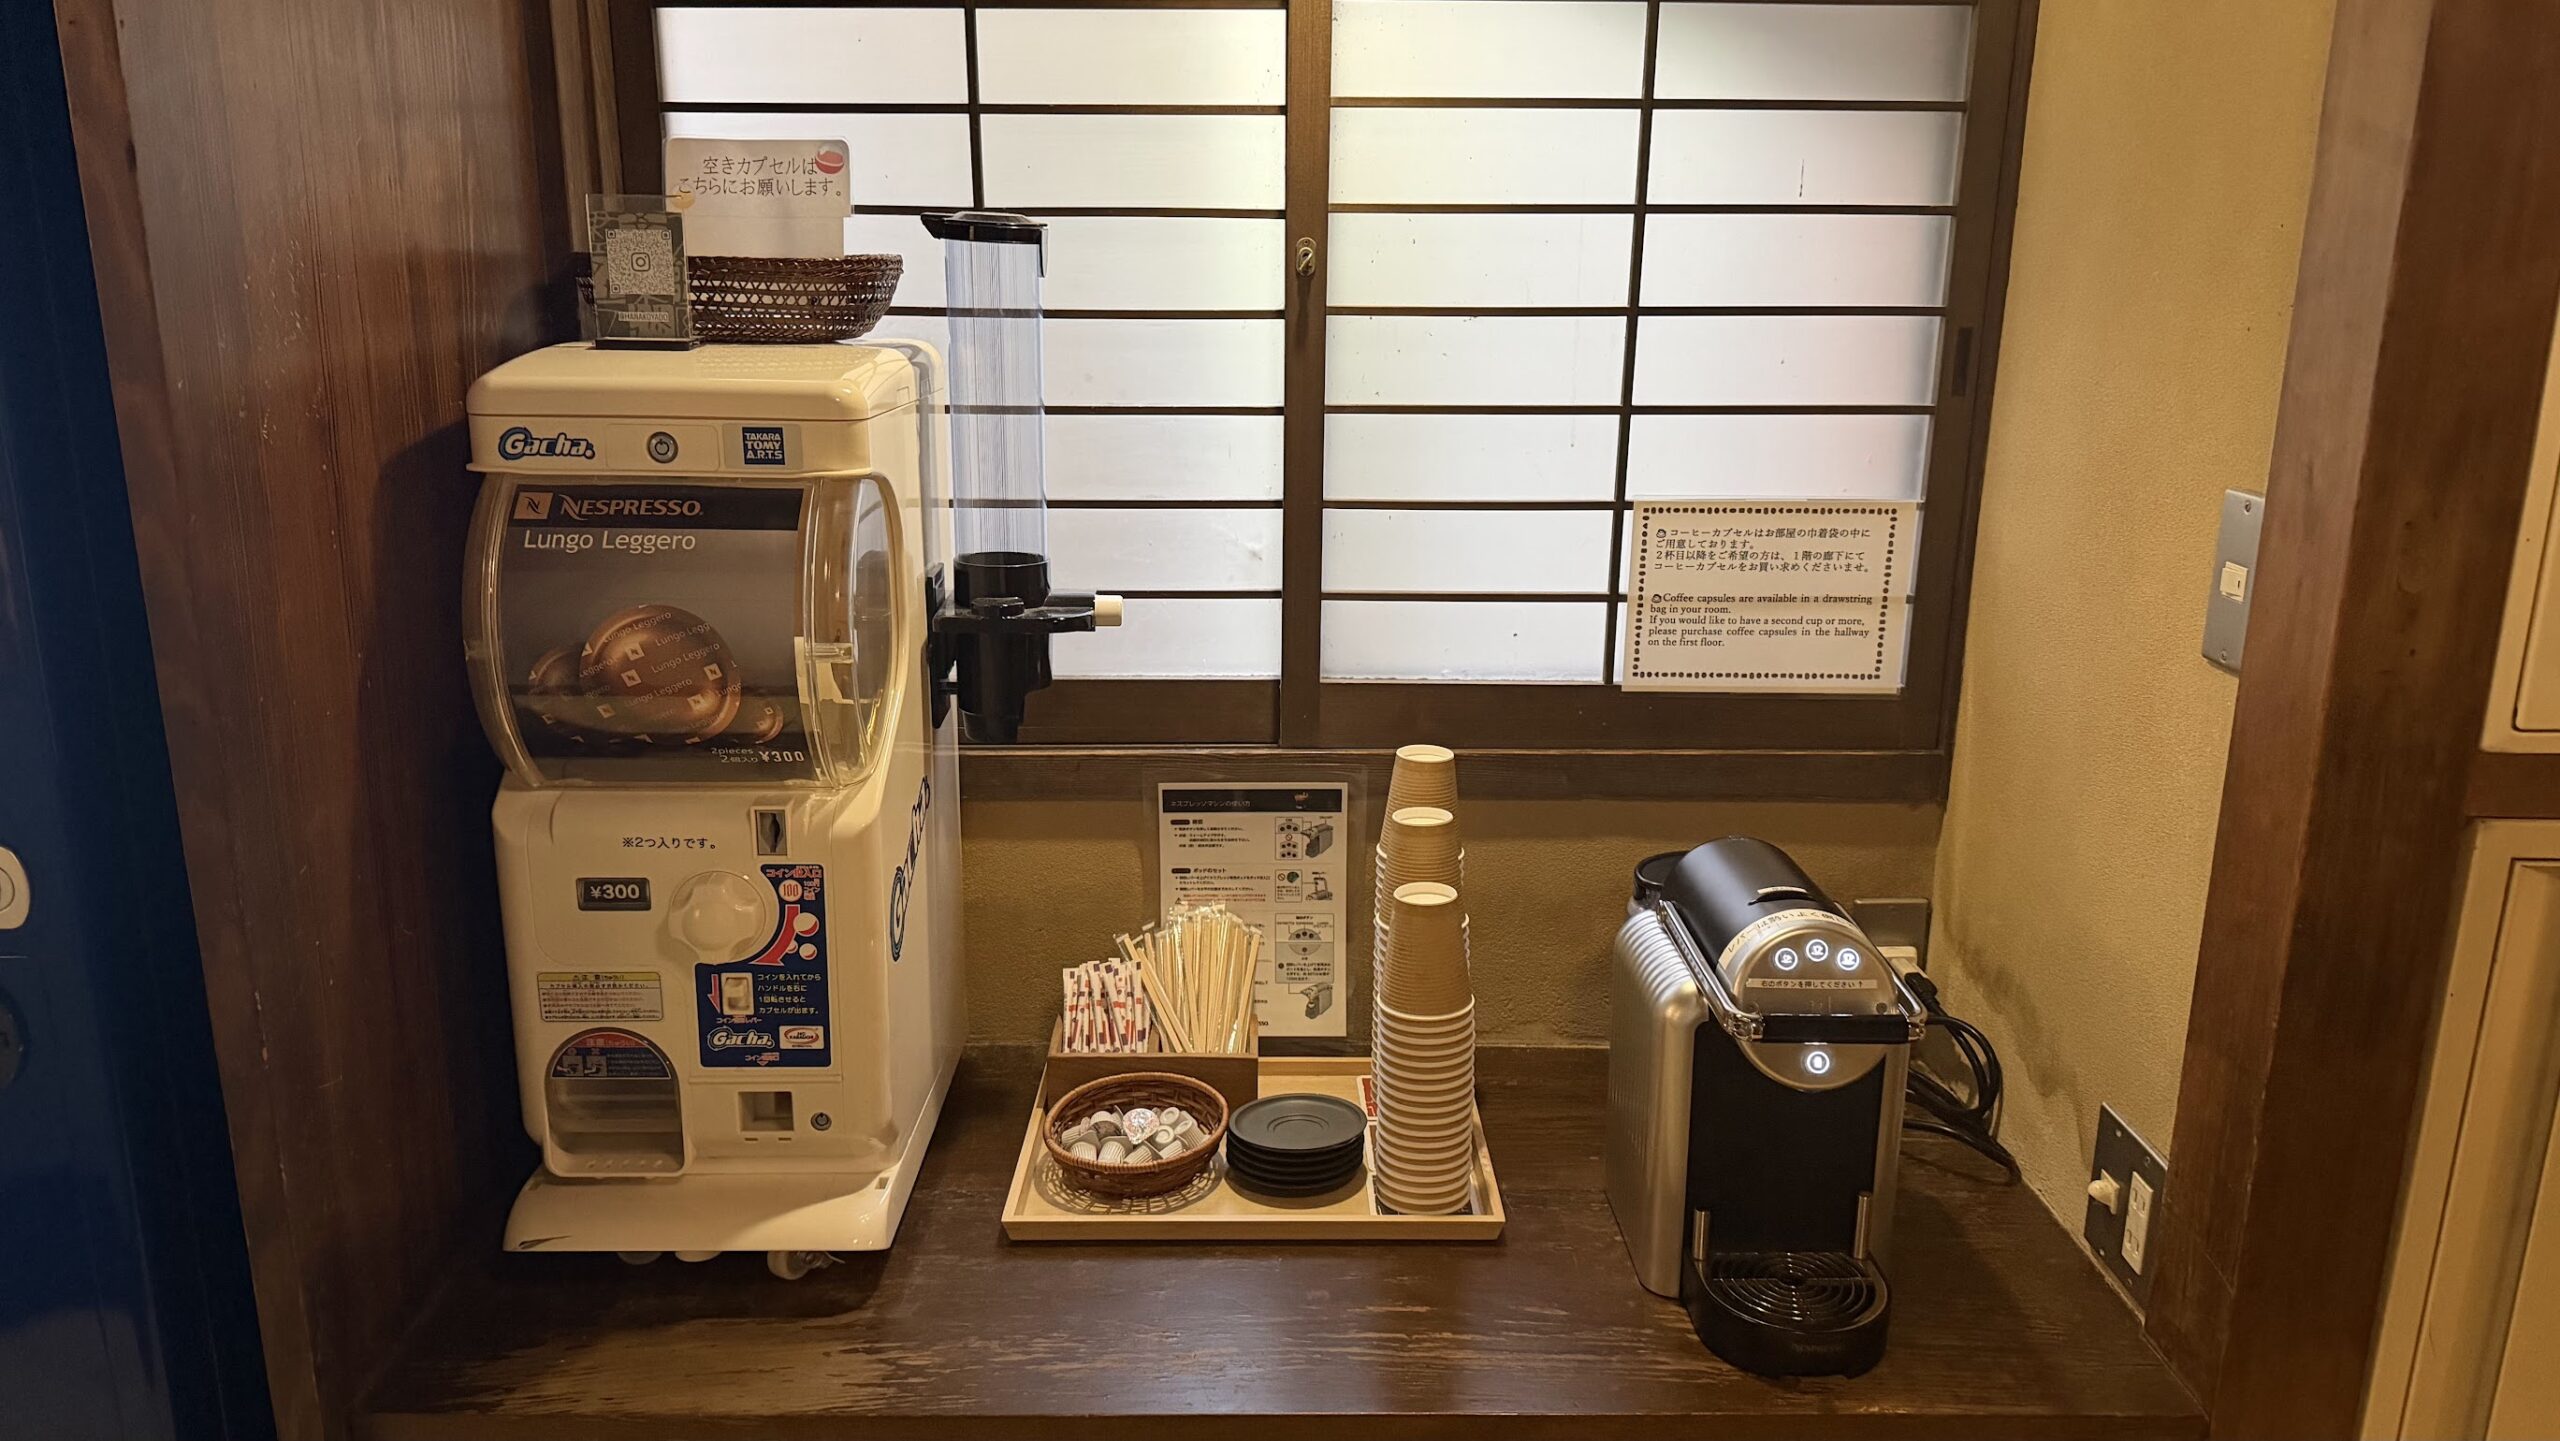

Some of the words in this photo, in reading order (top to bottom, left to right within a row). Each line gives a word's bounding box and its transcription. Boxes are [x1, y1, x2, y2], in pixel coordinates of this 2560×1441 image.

[702, 156, 817, 176] 空きカプセルは
[678, 178, 842, 197] こちらにお願いします。
[744, 432, 781, 442] TAKARA
[745, 441, 781, 450] TOMY
[524, 529, 594, 553] Lungo
[602, 530, 696, 554] Leggero
[1656, 539, 1754, 549] ご用意しております。
[1654, 562, 1869, 572] コーヒーカプセルをお買い求めくださいませ。
[1663, 593, 1694, 603] Coffee
[1697, 594, 1736, 605] capsules
[1757, 594, 1797, 603] available
[1801, 594, 1810, 603] in
[1822, 594, 1872, 605] drawstring
[1651, 605, 1667, 615] bag
[1670, 605, 1678, 614] in
[1681, 606, 1701, 616] your
[1705, 606, 1731, 614] room.
[1650, 616, 1658, 625] If
[1659, 617, 1676, 627] you
[1679, 616, 1706, 625] would
[1709, 616, 1726, 625] like
[1728, 617, 1737, 625] to
[1740, 616, 1760, 625] have
[1771, 616, 1803, 625] second
[1806, 617, 1822, 627] cup
[1838, 618, 1864, 626] more,
[1649, 627, 1677, 637] please
[1681, 627, 1722, 638] purchase
[1726, 627, 1754, 636] coffee
[1759, 627, 1797, 638] capsules
[1801, 628, 1810, 636] in
[1815, 628, 1830, 636] the
[1834, 628, 1869, 638] hallway
[655, 630, 686, 647] Lungo
[1662, 638, 1676, 646] the
[1680, 638, 1697, 646] first
[1700, 638, 1725, 647] floor.
[651, 658, 681, 674] Lungo
[683, 643, 720, 661] Leggero
[759, 751, 804, 762] ¥300
[622, 837, 716, 849] ※2つ入りです。
[590, 884, 640, 899] ¥300
[783, 883, 799, 897] 100
